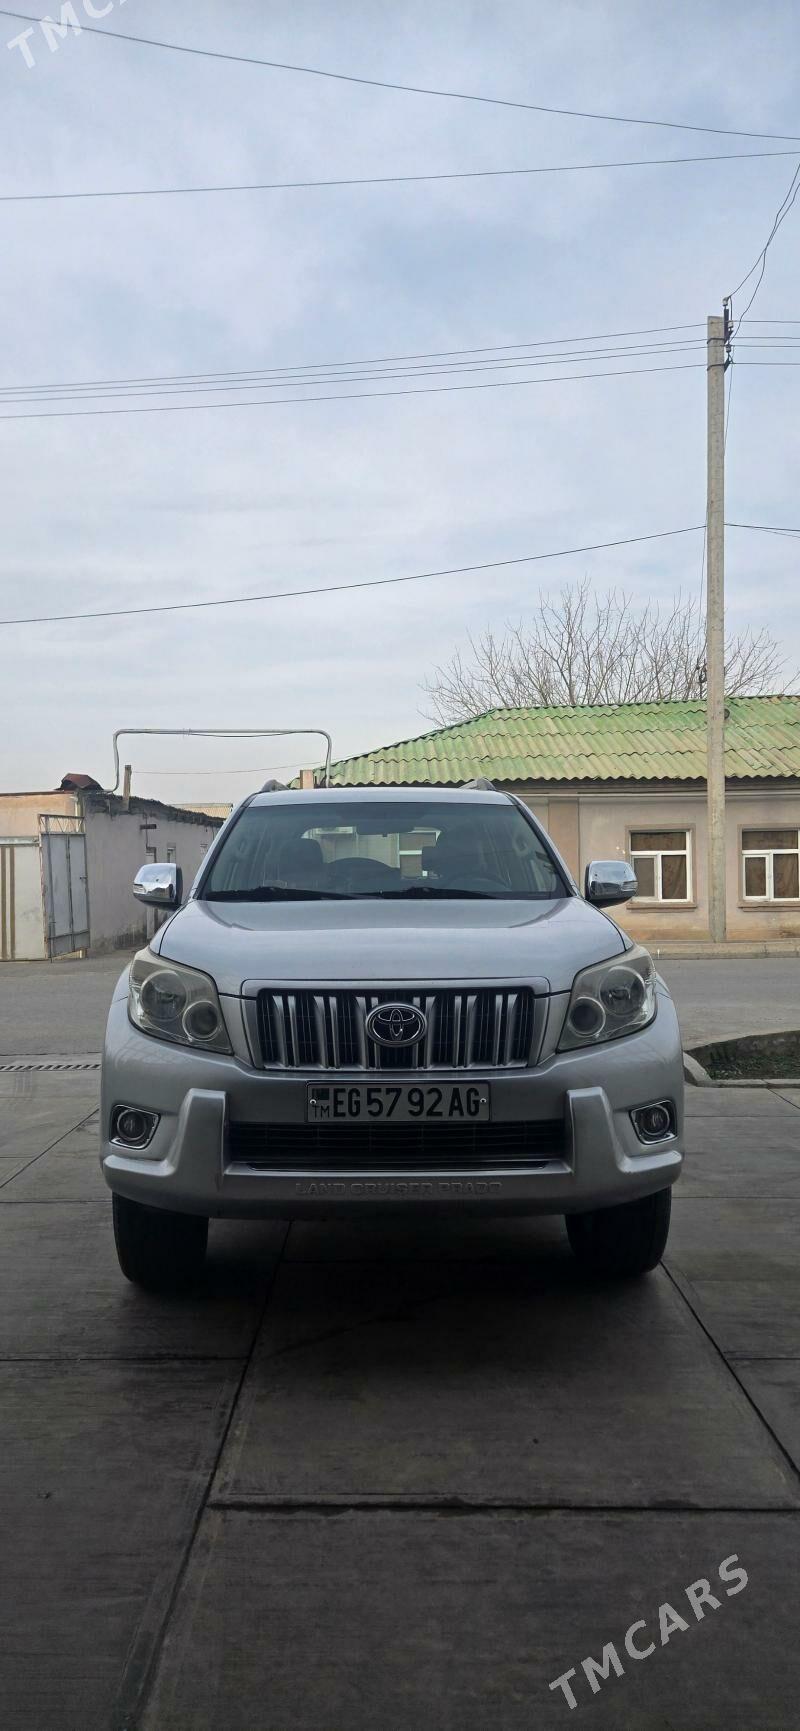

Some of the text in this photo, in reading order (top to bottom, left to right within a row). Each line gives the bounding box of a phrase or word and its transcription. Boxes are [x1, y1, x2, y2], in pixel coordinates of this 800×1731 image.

[312, 1105, 330, 1120] TM
[296, 1182, 503, 1195] LAND CRUISER PRADO
